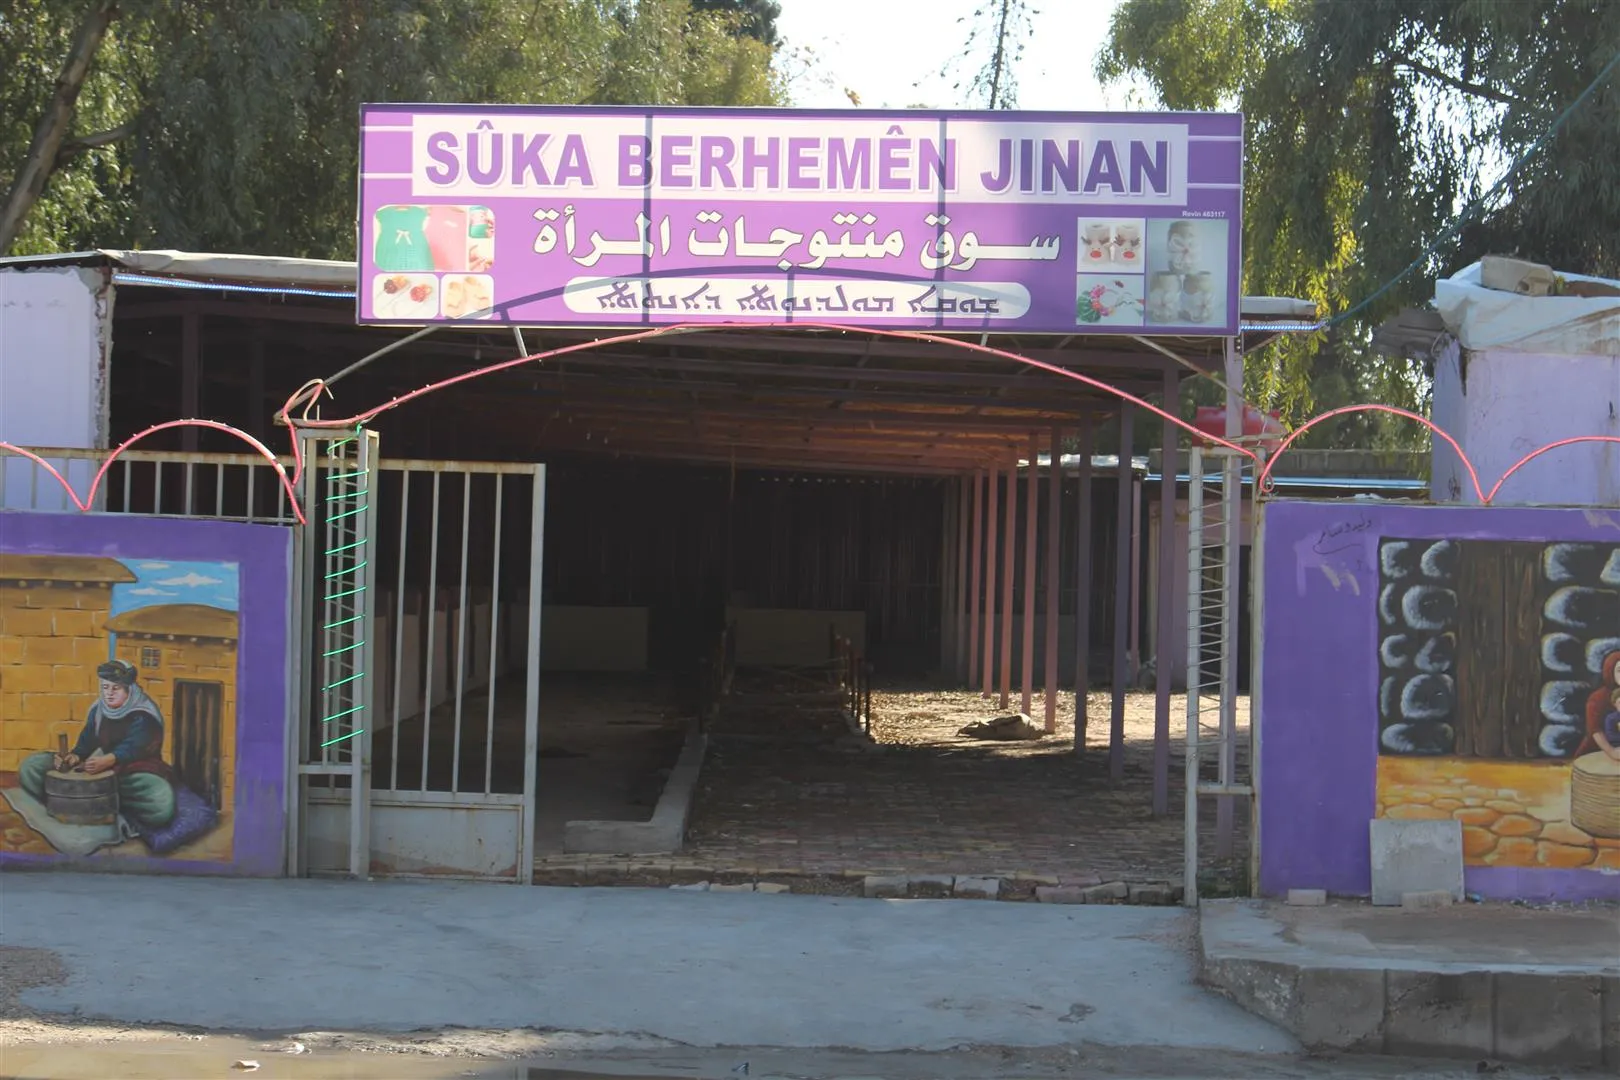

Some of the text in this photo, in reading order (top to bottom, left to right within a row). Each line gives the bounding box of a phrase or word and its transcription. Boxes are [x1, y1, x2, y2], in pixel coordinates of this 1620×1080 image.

[425, 119, 1168, 194] SÛKA BERHEMÊN JINAN
[532, 204, 1061, 272] سوق منتوجات المرأة
[907, 283, 1000, 314] ܫܘܩܐ
